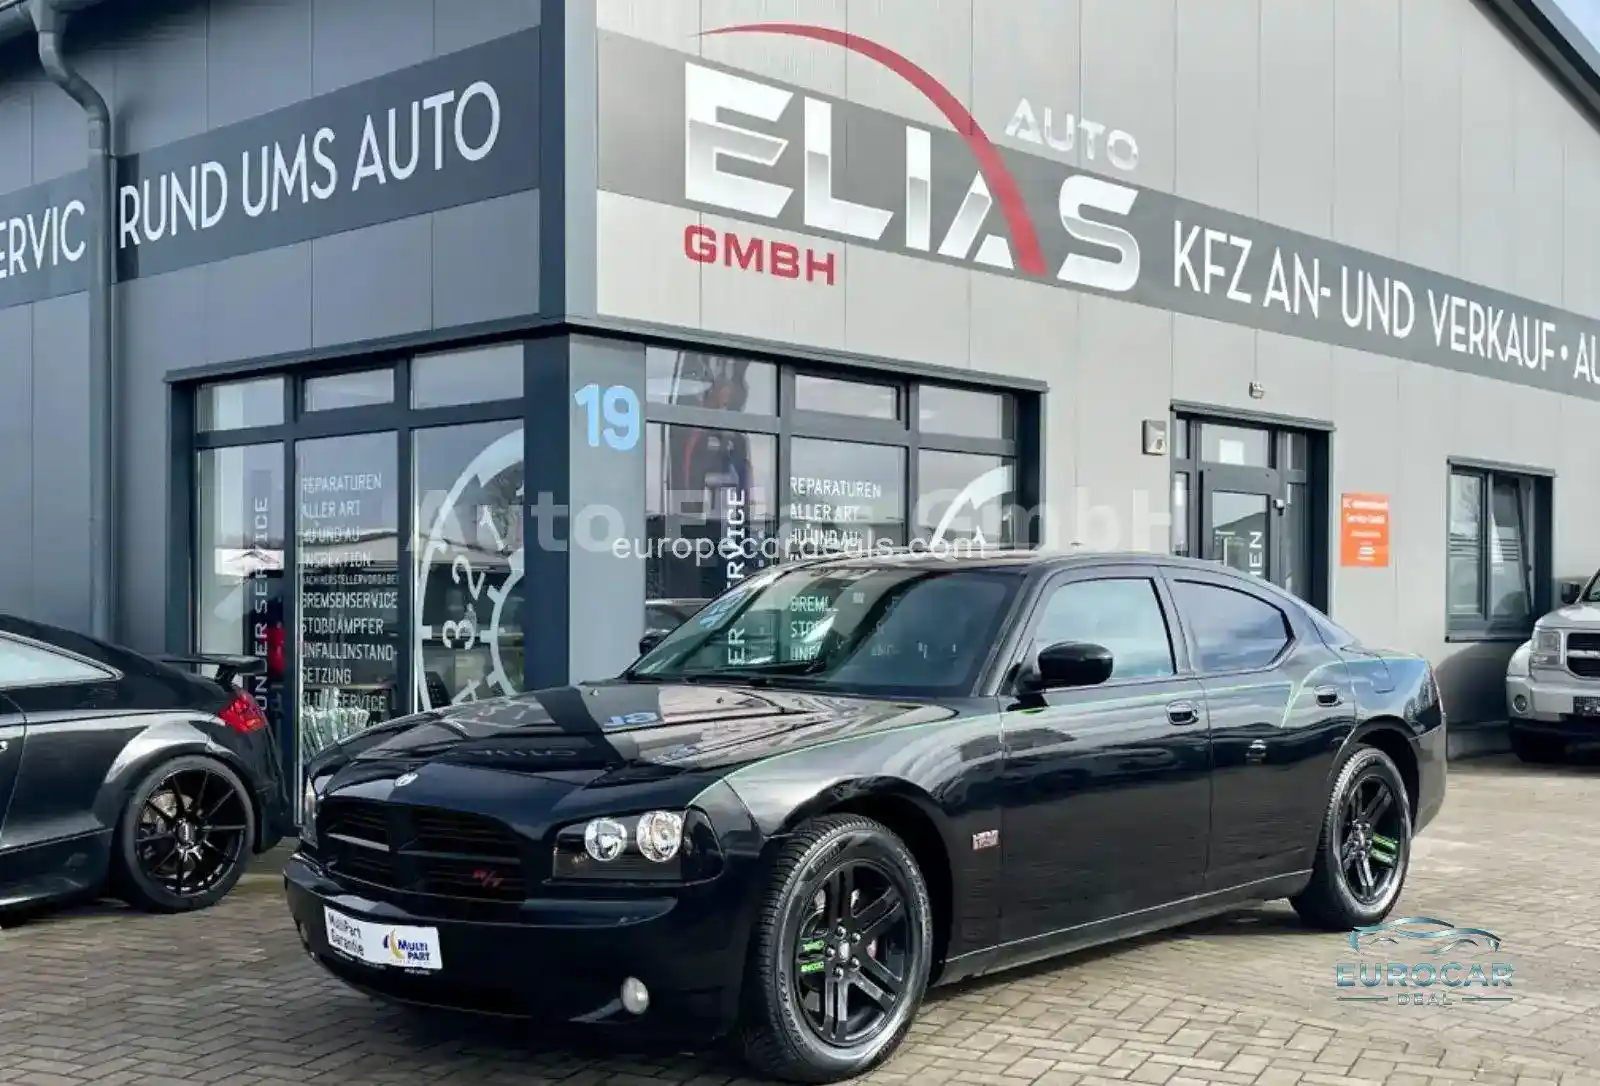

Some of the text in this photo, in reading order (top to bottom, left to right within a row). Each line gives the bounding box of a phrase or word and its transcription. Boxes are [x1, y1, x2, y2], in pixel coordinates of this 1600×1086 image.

[119, 80, 500, 248] RUND UMS AUTO
[1003, 97, 1140, 171] AUTO
[685, 61, 1141, 292] ELIAS
[684, 223, 836, 285] GMBH
[1173, 220, 1253, 304] KFZ
[1262, 246, 1331, 319] AN-
[1341, 265, 1416, 339] UND
[1427, 288, 1556, 371] VERKAUF
[574, 383, 641, 450] 19
[789, 476, 882, 499] REPARATUREN
[790, 503, 832, 521] ALLER
[407, 951, 431, 961] PART
